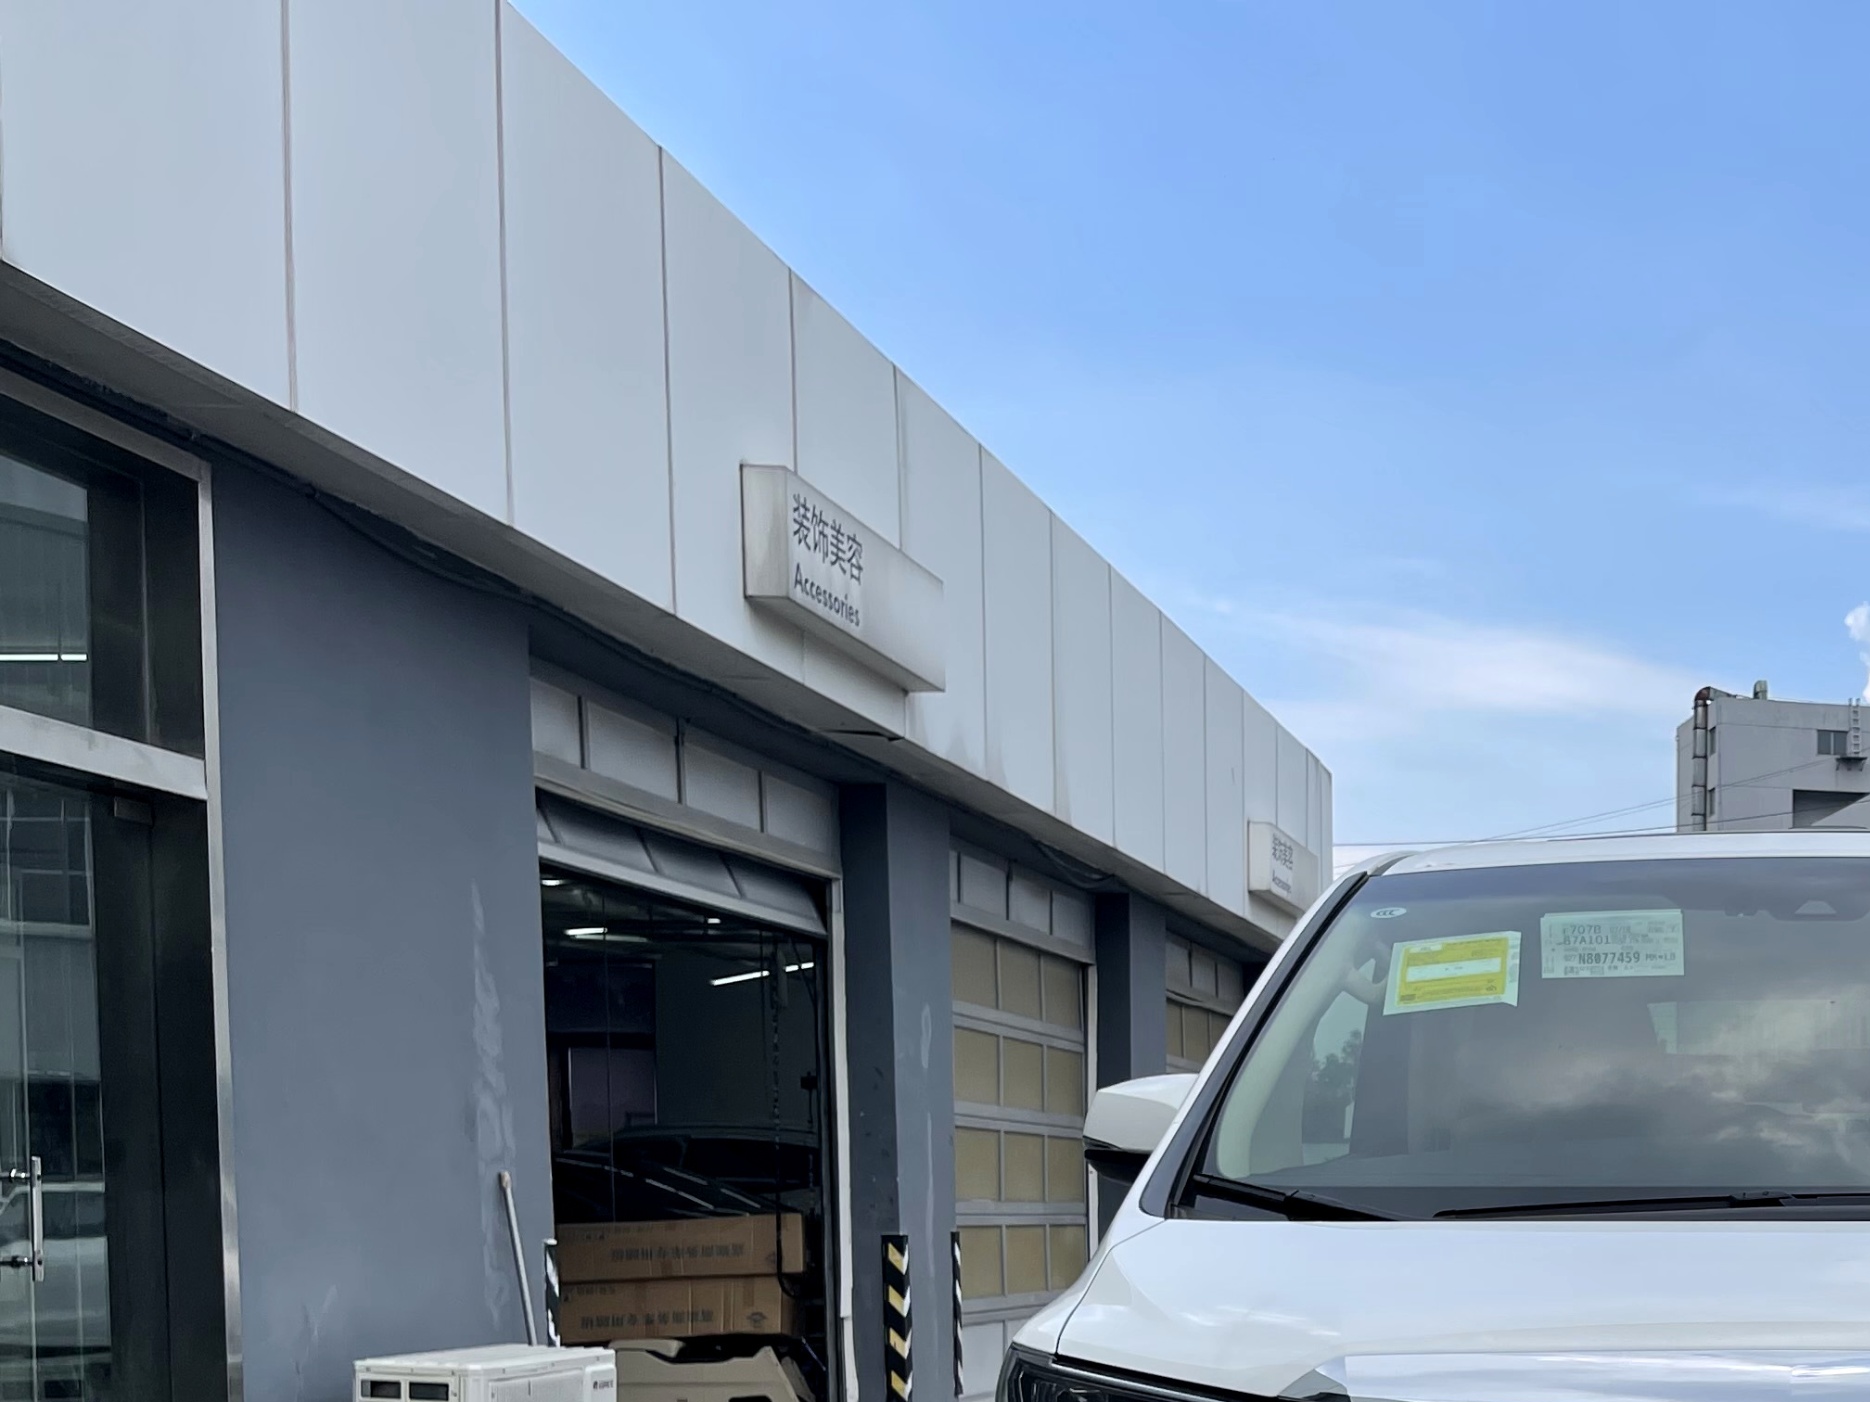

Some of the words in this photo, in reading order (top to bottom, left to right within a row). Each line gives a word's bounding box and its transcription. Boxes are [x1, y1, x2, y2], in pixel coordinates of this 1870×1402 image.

[792, 493, 863, 586] 装饰美容
[794, 562, 860, 627] Accessories
